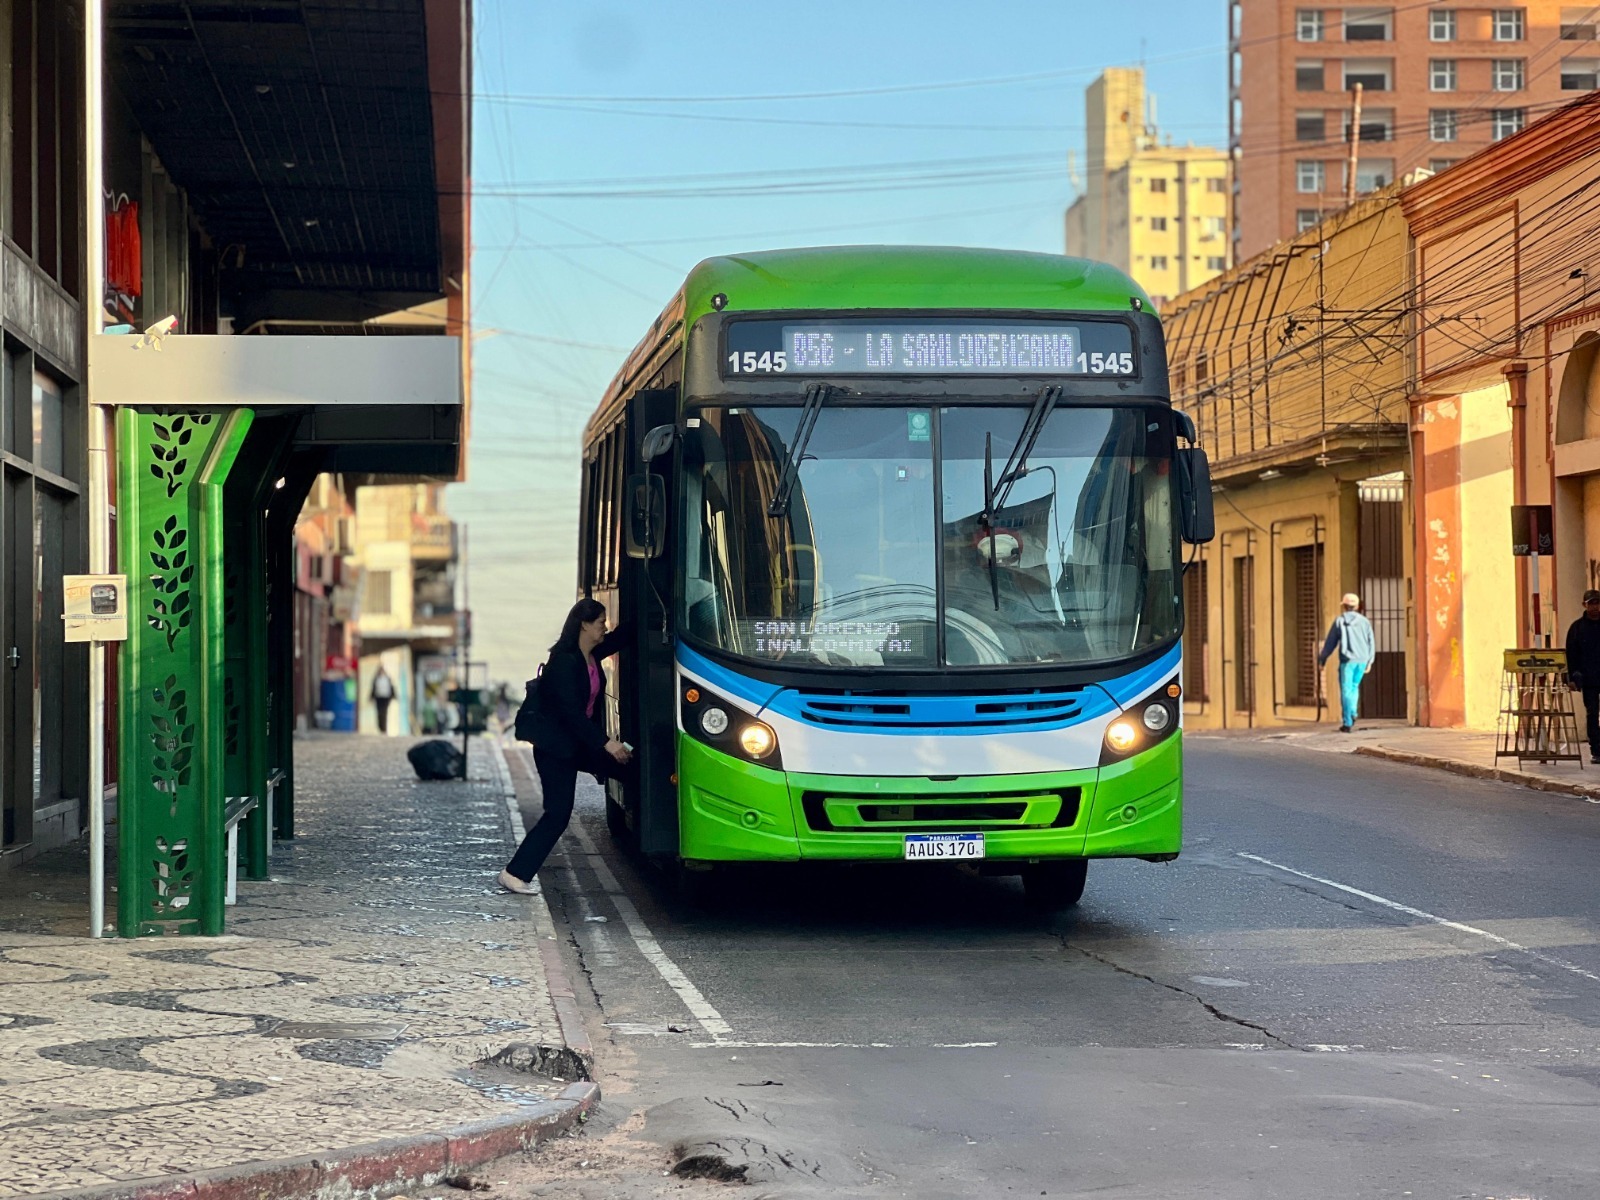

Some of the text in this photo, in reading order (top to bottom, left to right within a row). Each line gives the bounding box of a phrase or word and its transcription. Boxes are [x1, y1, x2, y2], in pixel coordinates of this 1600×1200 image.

[794, 333, 834, 366] 056
[866, 333, 893, 366] LA
[902, 333, 1073, 367] SANLORENZANA
[728, 351, 787, 373] 1545
[1077, 352, 1134, 373] 1545
[754, 622, 900, 635] SAN LORENZO
